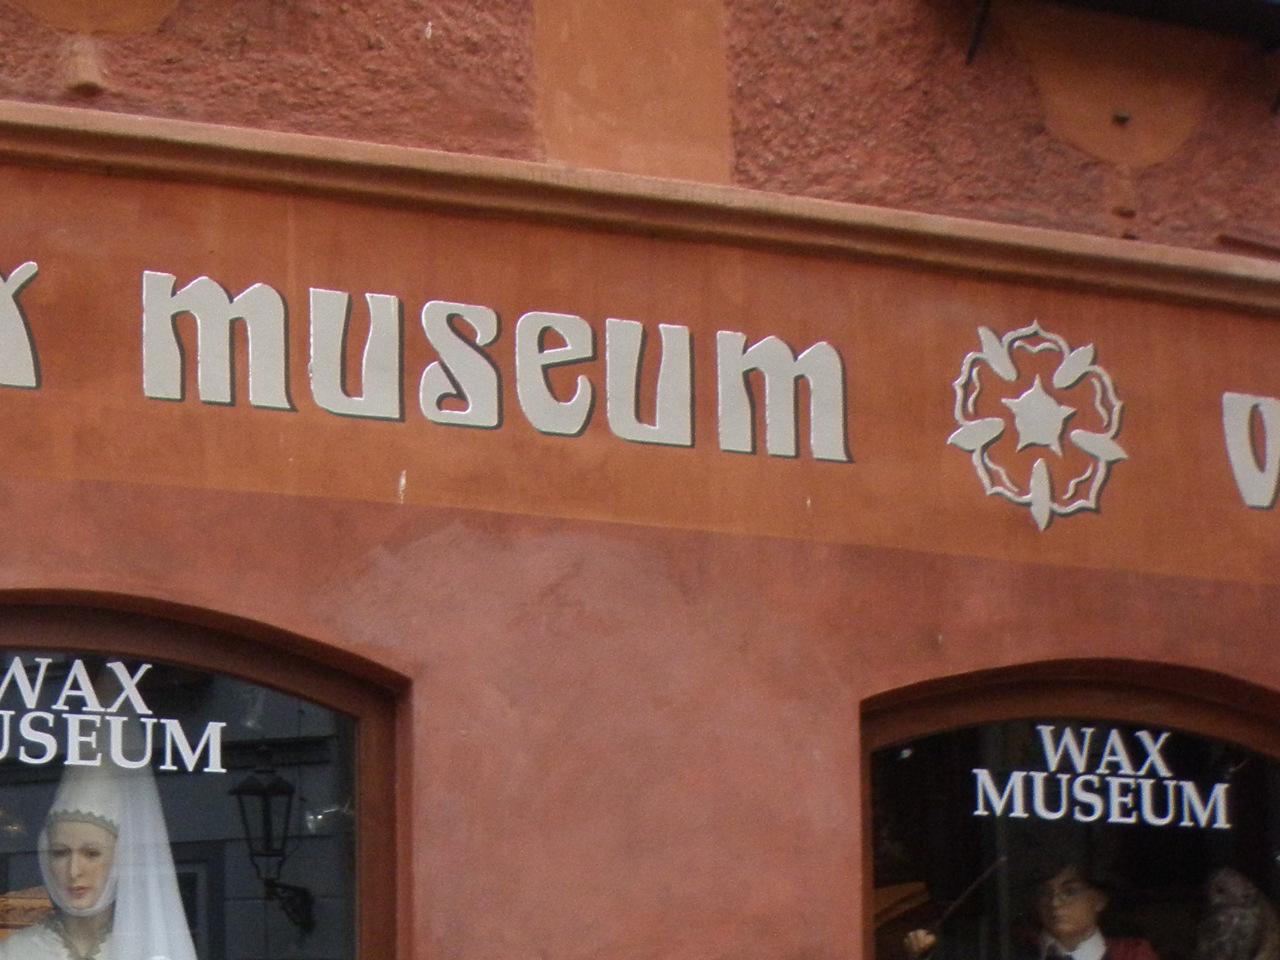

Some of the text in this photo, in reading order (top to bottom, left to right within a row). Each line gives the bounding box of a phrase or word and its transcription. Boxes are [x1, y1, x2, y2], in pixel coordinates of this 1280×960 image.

[142, 270, 849, 463] museum
[1036, 725, 1173, 778] WAX
[972, 768, 1231, 829] MUSEUM
